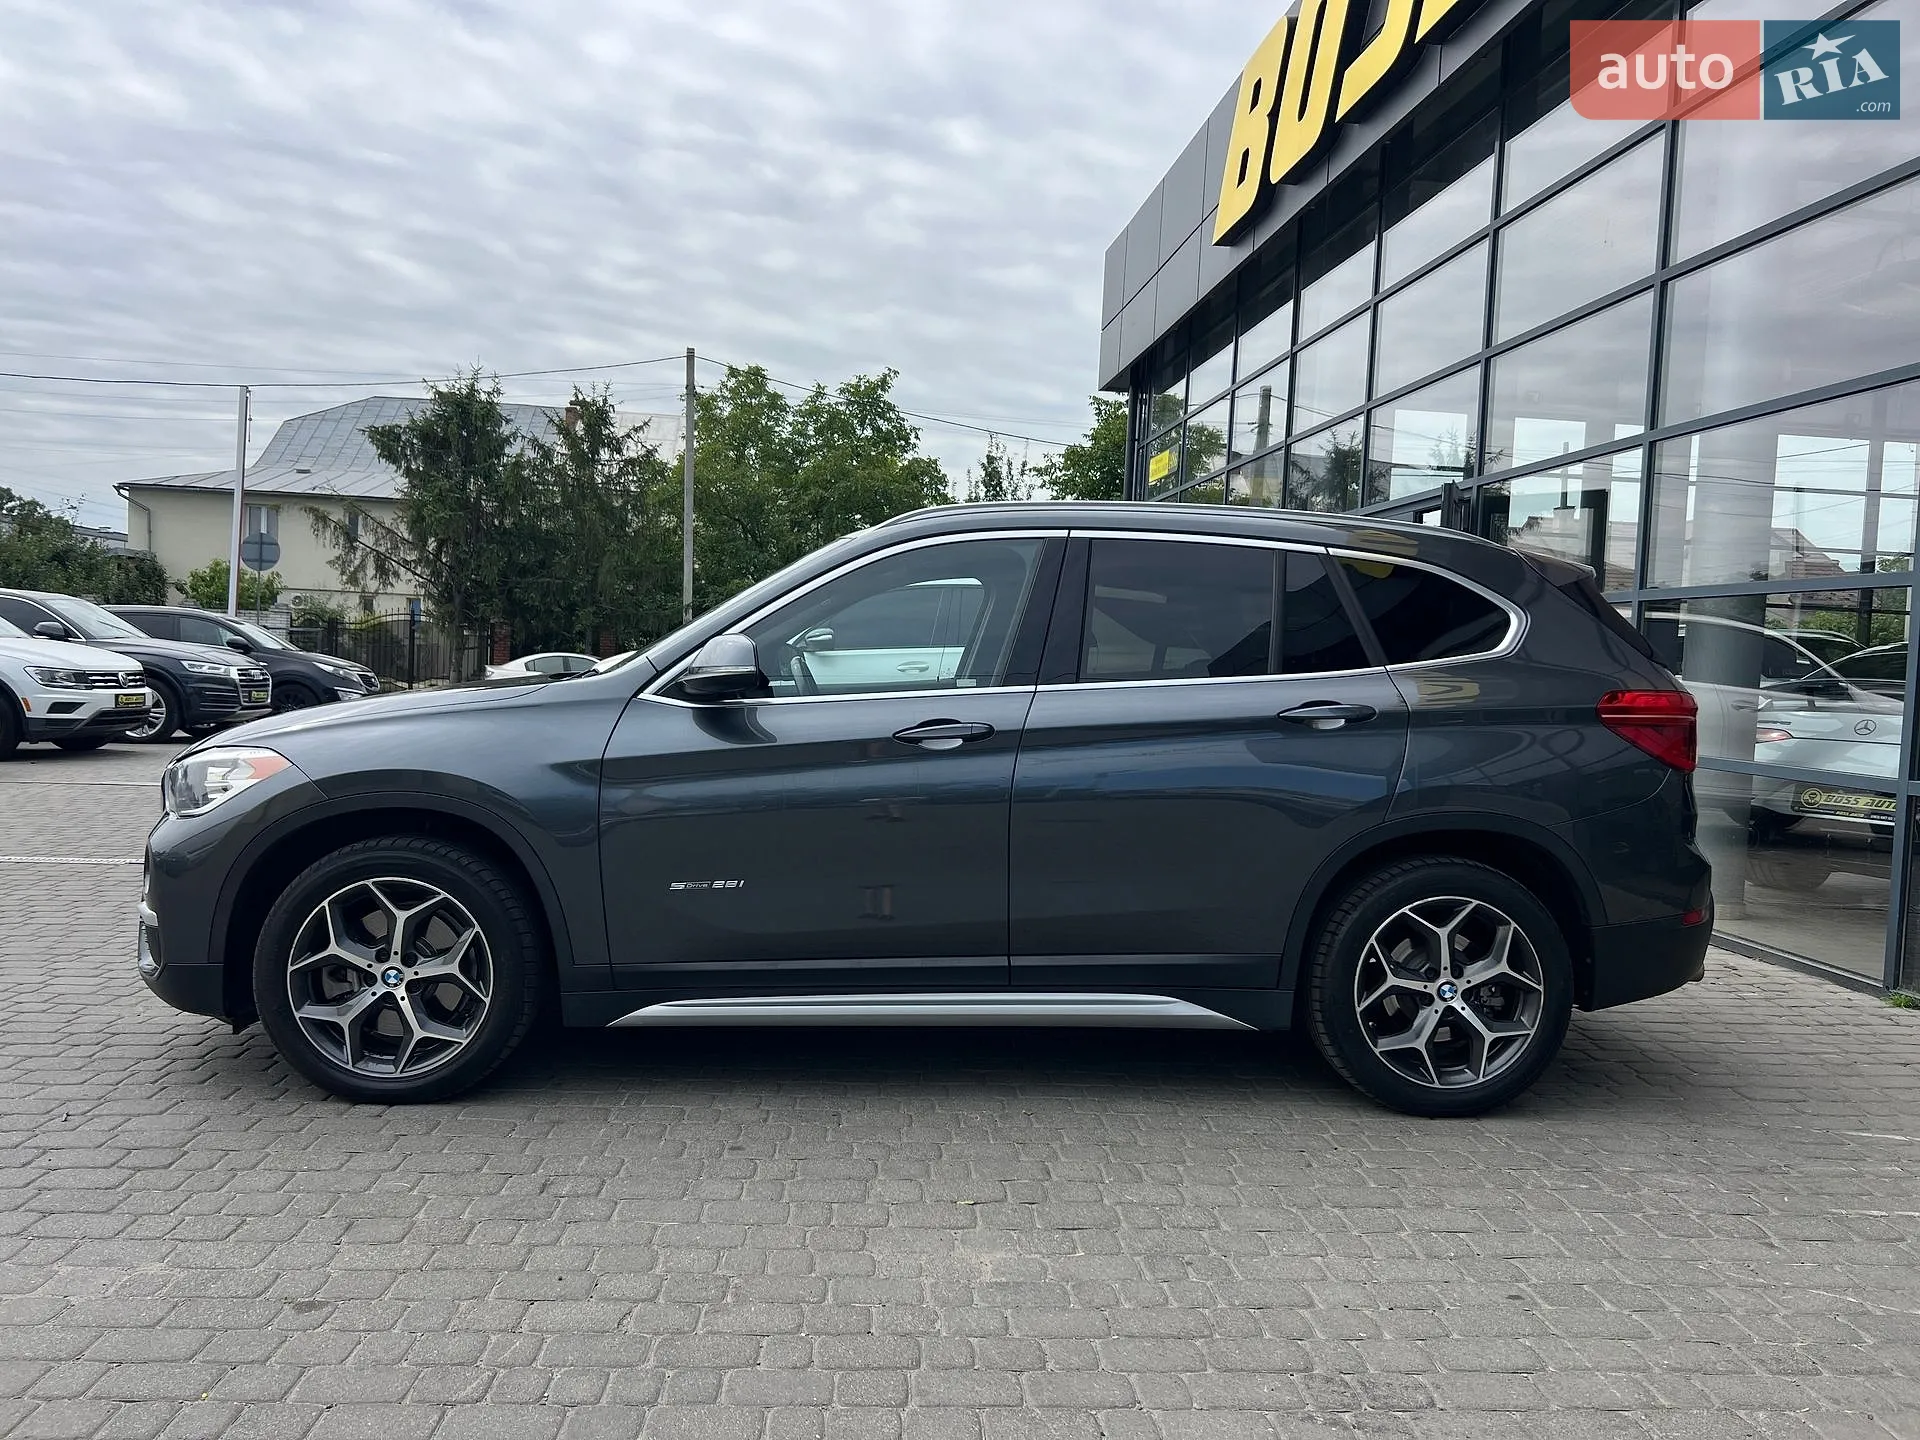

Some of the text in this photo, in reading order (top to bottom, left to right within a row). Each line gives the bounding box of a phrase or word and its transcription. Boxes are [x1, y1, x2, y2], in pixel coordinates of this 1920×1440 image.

[1212, 0, 1459, 246] BO
[1823, 794, 1897, 810] BOSS AUT
